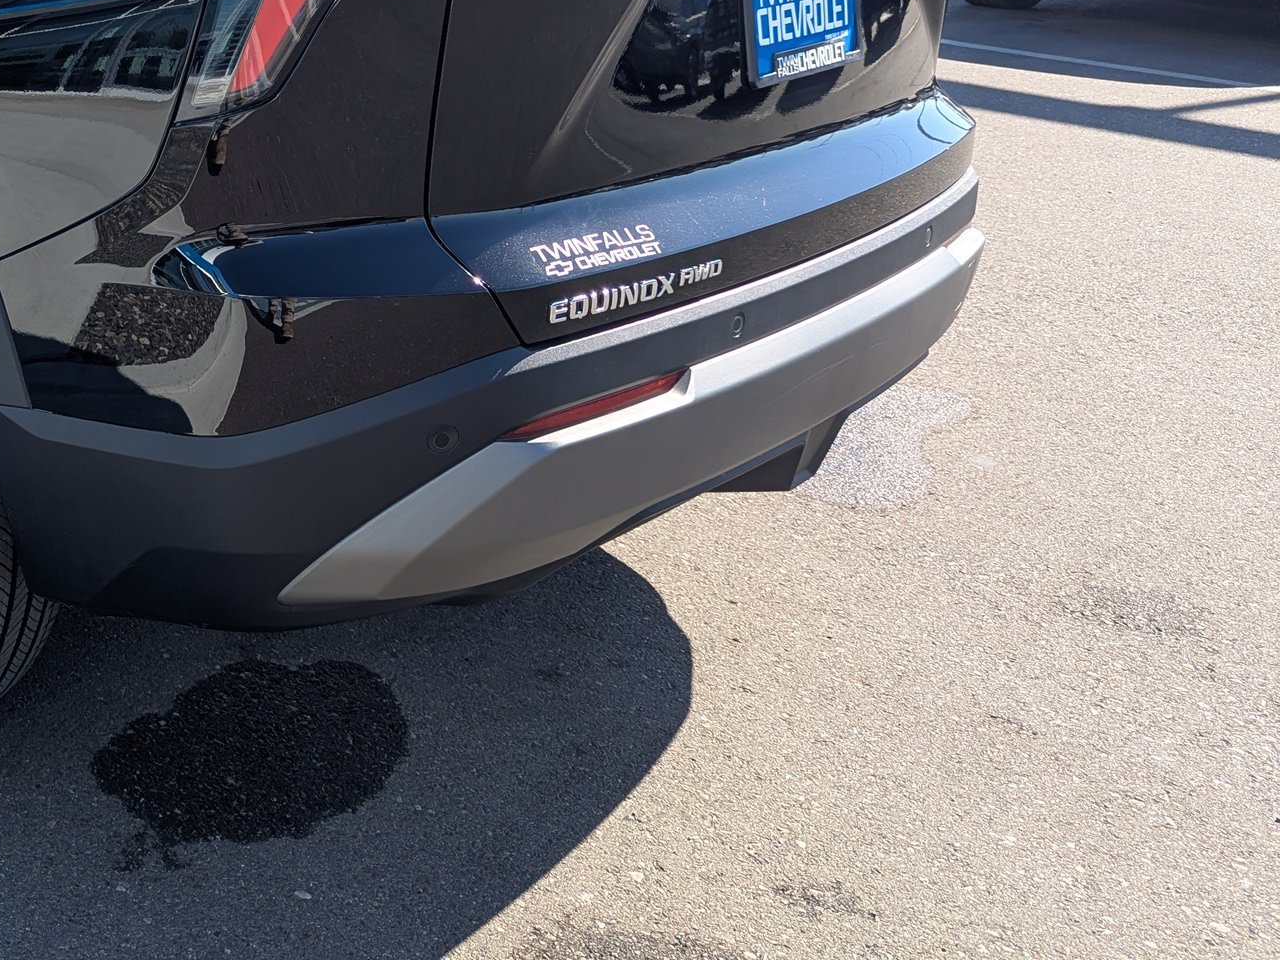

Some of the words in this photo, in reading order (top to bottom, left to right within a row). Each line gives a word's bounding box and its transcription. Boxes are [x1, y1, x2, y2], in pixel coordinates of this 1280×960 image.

[797, 41, 846, 72] CHEVROLET
[530, 224, 656, 263] TWINFALLS
[575, 241, 663, 270] CHEVROLET
[549, 272, 676, 324] EQUINOX
[679, 259, 724, 287] AWD
